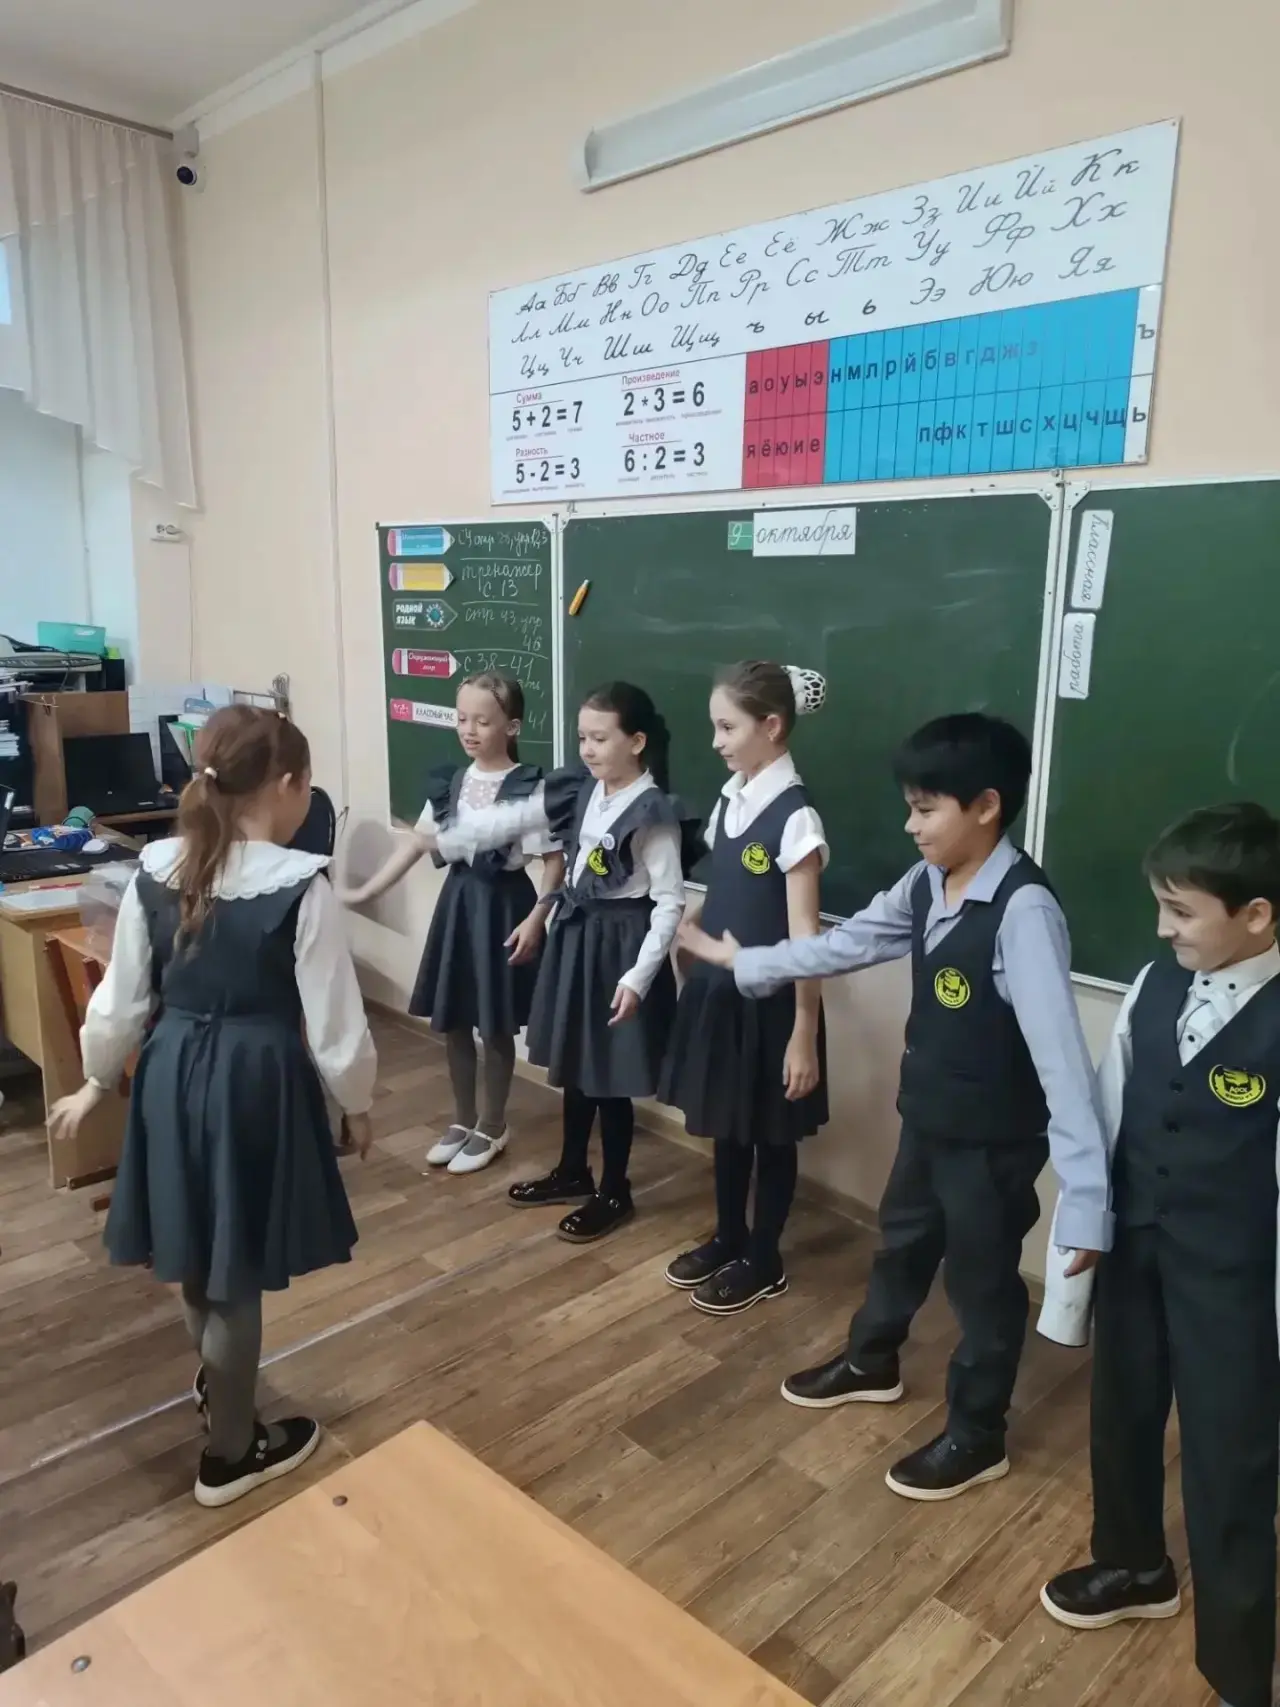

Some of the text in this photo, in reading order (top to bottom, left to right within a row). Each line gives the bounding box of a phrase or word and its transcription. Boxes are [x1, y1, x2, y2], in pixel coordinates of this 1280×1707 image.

[516, 292, 546, 315] Аа
[554, 282, 588, 306] Бб
[592, 272, 620, 297] Вв
[628, 262, 656, 289] Гг
[669, 253, 709, 283] Дд
[719, 243, 747, 267] Ее
[815, 213, 890, 245] Жж
[902, 195, 943, 229] Зз
[956, 181, 1003, 213] Ии
[1015, 164, 1057, 199] Йй
[1071, 148, 1140, 186] Кк
[511, 192, 1128, 344] Лл Мм Нн Оо Пп Рр Сс Тт Уу Фф Хх
[520, 245, 1117, 379] Цц Чч Шш Щщ ъ ы ь Ээ Юю Яя
[621, 368, 680, 386] Произведение
[516, 391, 543, 404] Сумма
[628, 432, 665, 443] Частное
[515, 447, 549, 457] Разность
[756, 510, 852, 555] октября
[1081, 514, 1109, 603] Классная
[502, 579, 519, 597] 13
[396, 603, 423, 614] РОДНОЙ
[396, 616, 416, 625] ЯЗЫК
[1063, 620, 1086, 697] работа
